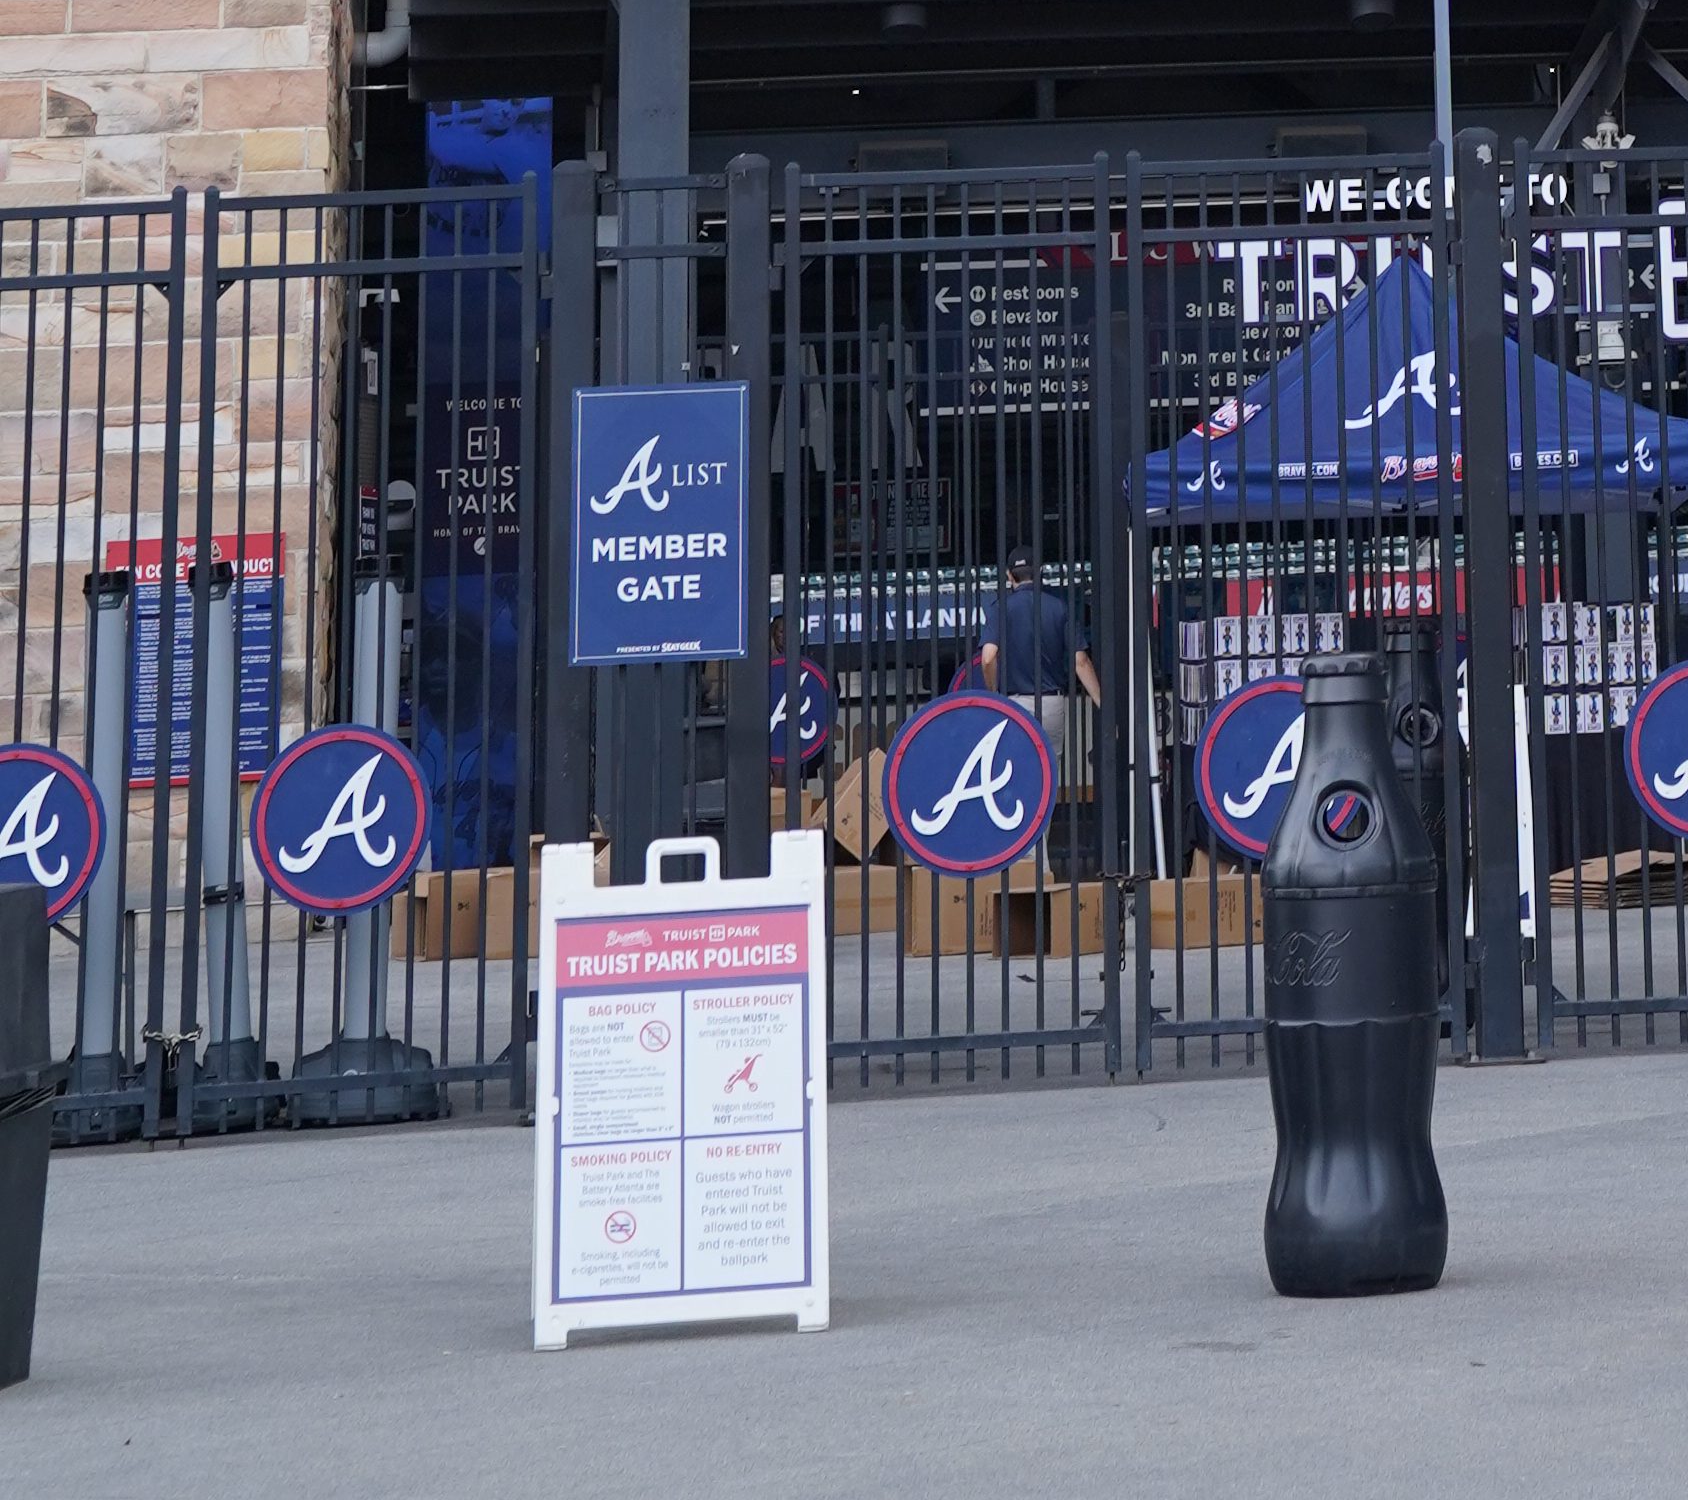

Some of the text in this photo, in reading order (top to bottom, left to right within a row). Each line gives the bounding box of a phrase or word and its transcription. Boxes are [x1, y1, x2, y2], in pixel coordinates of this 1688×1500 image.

[1306, 174, 1503, 213] WECO
[1216, 230, 1622, 323] TRST
[446, 398, 505, 412] WELCOE
[590, 434, 728, 515] A LIST
[592, 533, 727, 563] MEMBER
[146, 565, 185, 579] COE
[617, 574, 702, 602] GATE
[616, 645, 651, 654] PRESENTED
[661, 640, 701, 653] SEATGEEK
[911, 718, 1024, 836] A
[279, 752, 396, 874] A
[663, 925, 760, 942] TRUIST PARK
[566, 943, 798, 978] TRUIST PARK POLICIES
[588, 1002, 657, 1017] BAG POLICY
[693, 993, 794, 1010] STROLLER POLICY
[742, 1013, 768, 1023] MUST
[607, 1022, 624, 1032] NOT
[714, 1115, 731, 1125] NOT
[571, 1149, 672, 1168] SMOKING POLICY
[706, 1142, 782, 1159] NO RE-ENTRY
[695, 1168, 793, 1184] Guests who have
[705, 1184, 784, 1199] entered Truist
[701, 1201, 787, 1216] Park will not be
[704, 1217, 785, 1233] allowed to exit
[698, 1234, 790, 1251] and re-enter the
[721, 1252, 768, 1267] ballpark
